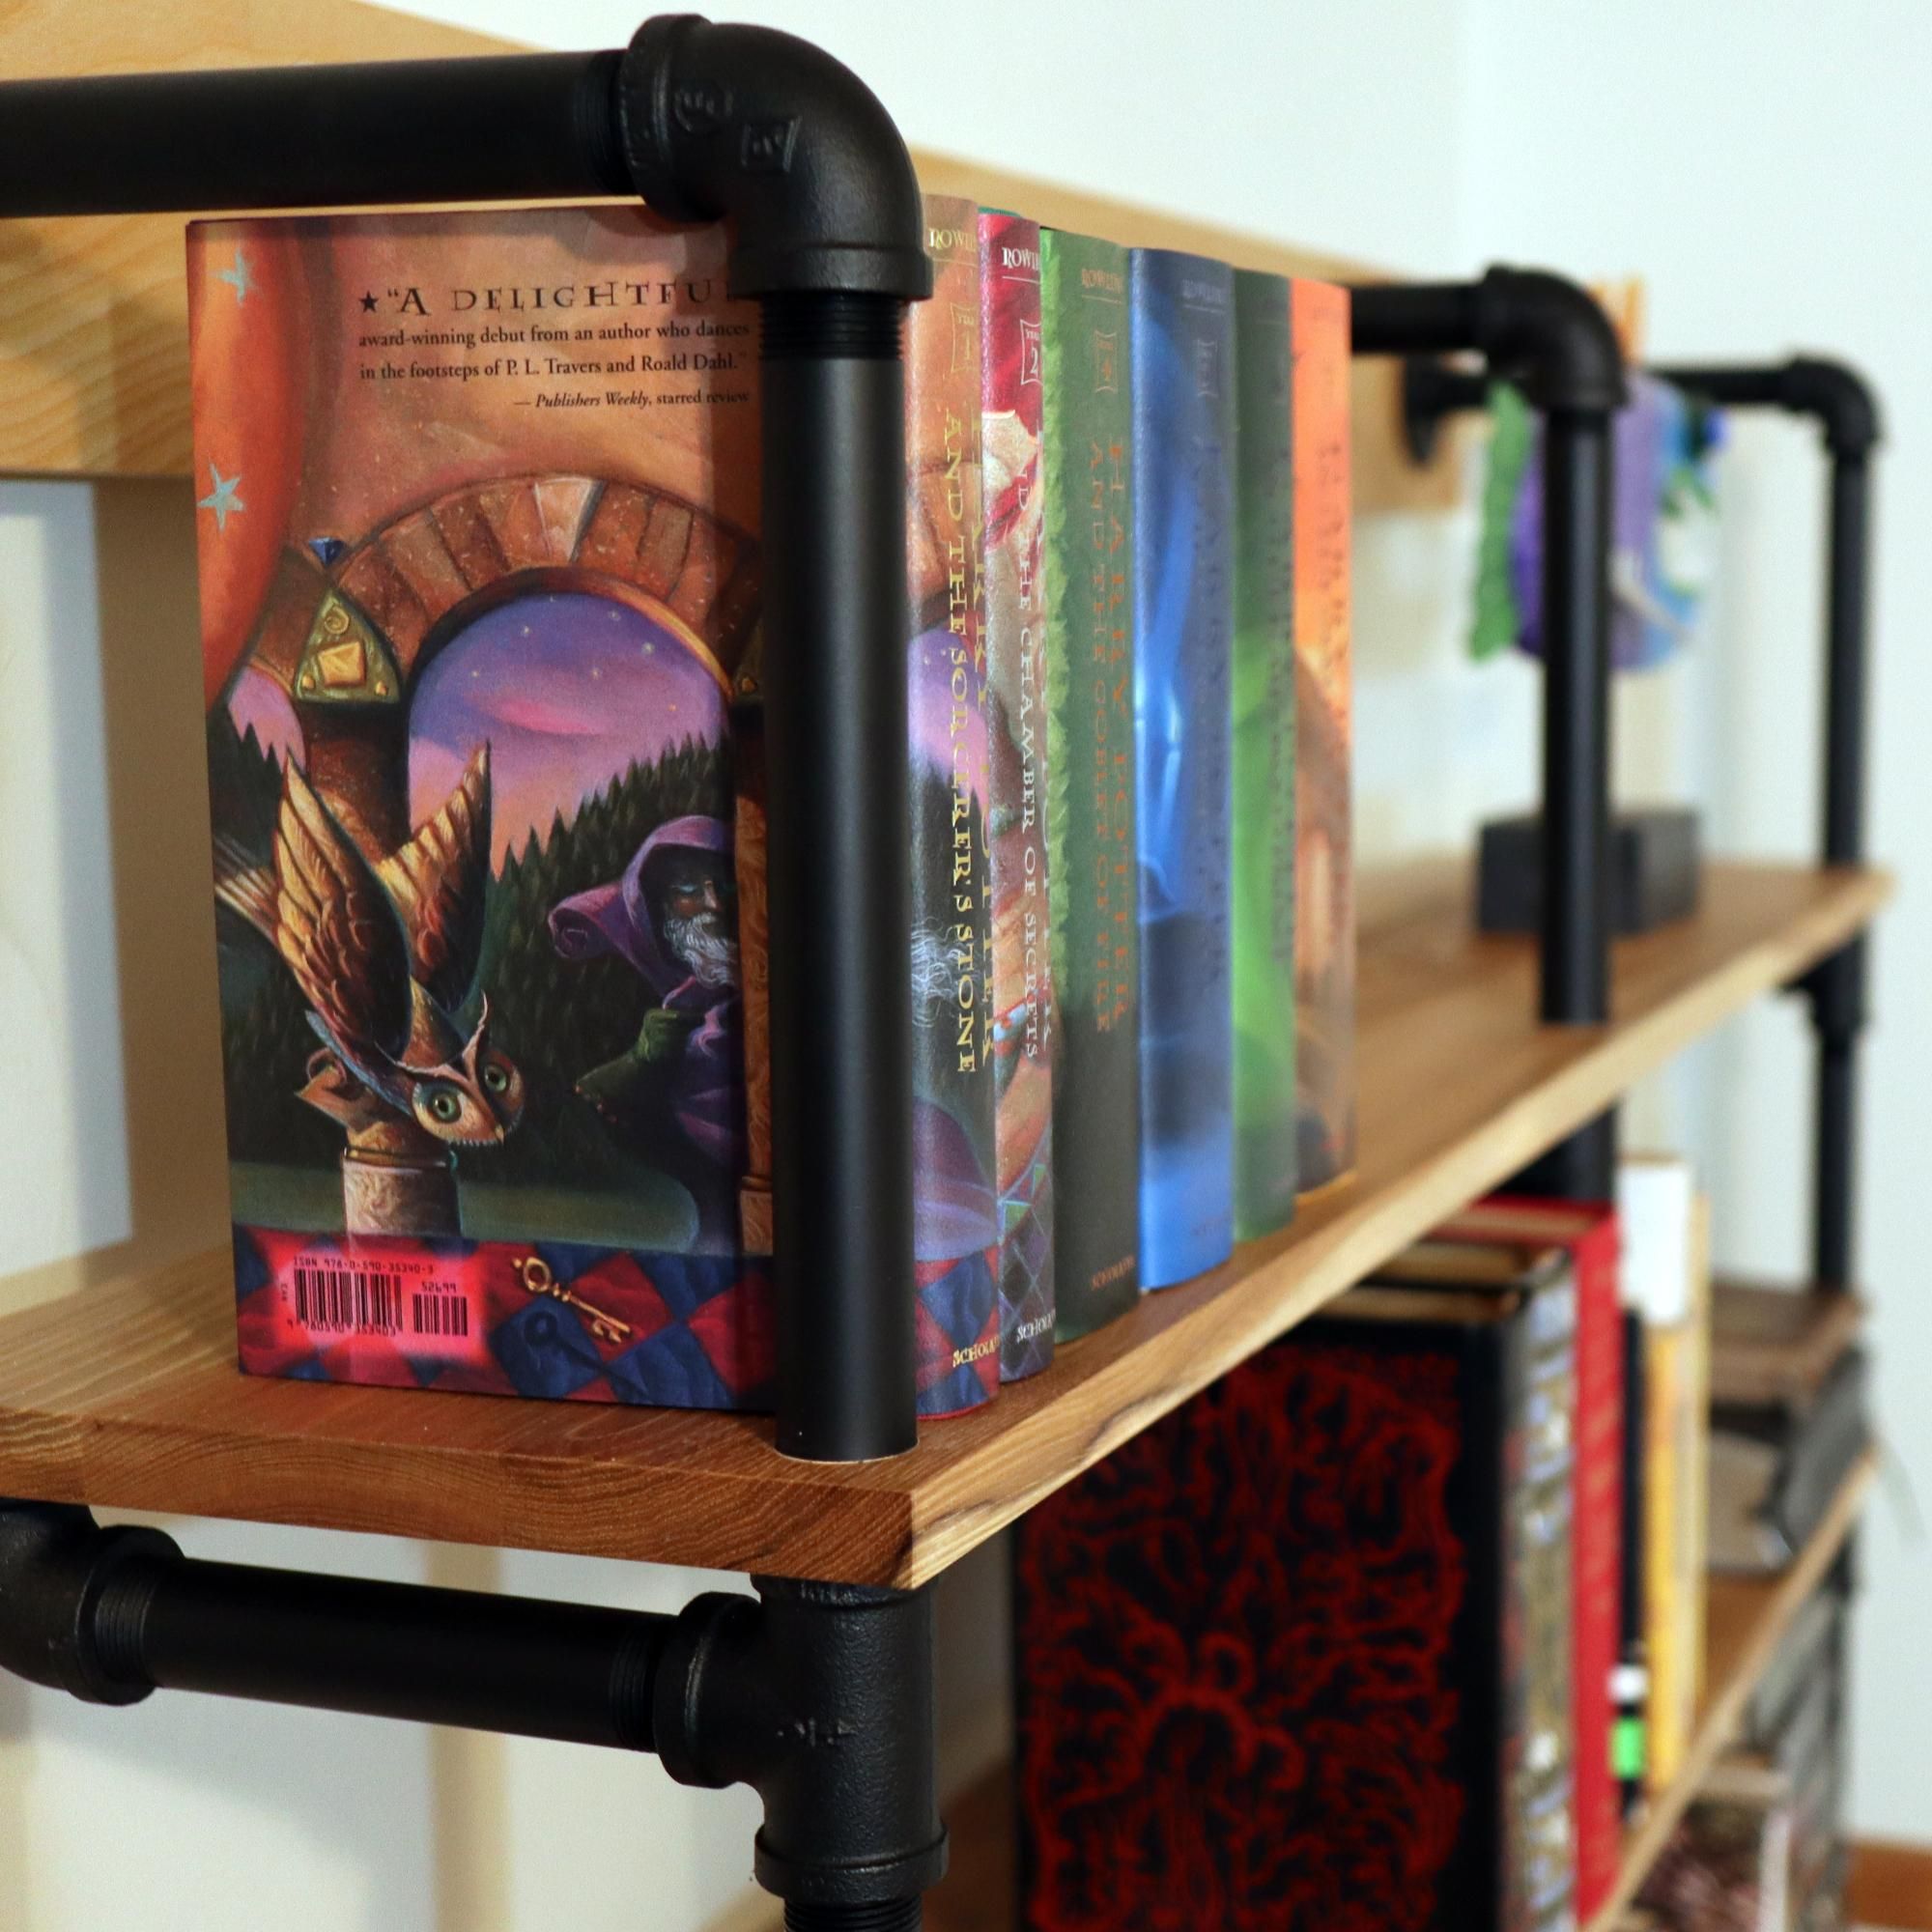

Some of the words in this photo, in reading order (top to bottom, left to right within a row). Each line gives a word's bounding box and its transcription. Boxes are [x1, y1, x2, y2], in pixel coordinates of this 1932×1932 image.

[358, 329, 477, 349] award-winning
[480, 327, 525, 344] debut
[531, 324, 569, 343] from
[574, 329, 593, 342] an
[598, 323, 651, 341] author
[657, 320, 690, 338] who
[696, 319, 751, 337] dances
[452, 279, 734, 312] DELIGHTFU
[360, 364, 376, 380] in
[381, 362, 406, 379] the
[411, 361, 480, 383] footsteps
[484, 358, 501, 376] of
[506, 359, 520, 375] P.
[525, 358, 540, 375] L.
[544, 358, 602, 375] Travers
[607, 355, 635, 373] and
[641, 354, 687, 372] Roald
[534, 393, 601, 409] Publishers
[606, 391, 653, 411] Weekly,
[656, 390, 702, 405] starred
[706, 390, 751, 405] review
[944, 407, 964, 522] AND
[948, 534, 967, 634] THE
[949, 647, 974, 913] SORCERER'S
[1019, 627, 1036, 834] CHAMBER
[1024, 846, 1037, 897] OF
[954, 923, 977, 1073] STONE
[1024, 912, 1039, 1060] SECRETS
